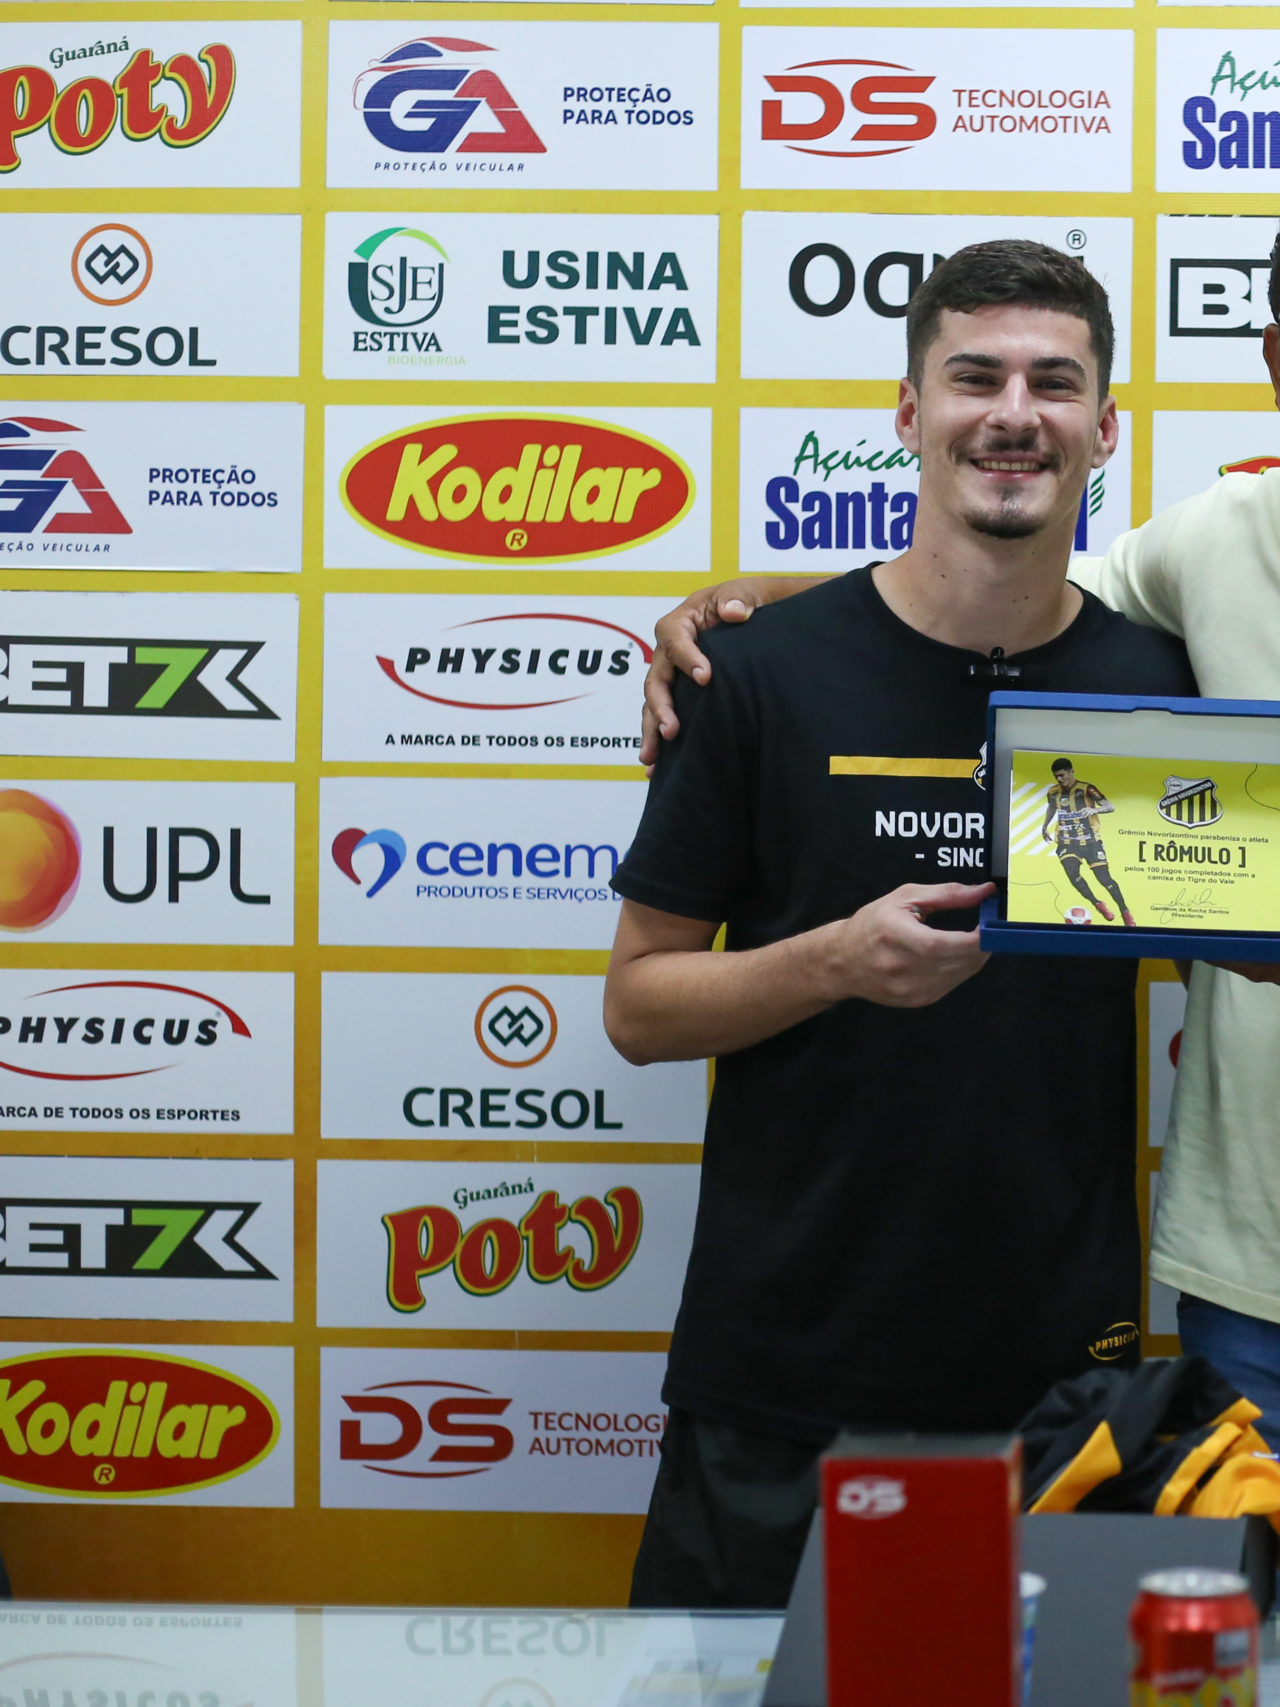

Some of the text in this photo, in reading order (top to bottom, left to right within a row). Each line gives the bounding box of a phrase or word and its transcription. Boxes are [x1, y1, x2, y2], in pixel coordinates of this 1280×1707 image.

[564, 84, 671, 107] PROTEÇÃO
[952, 89, 1110, 108] TECNOLOGIA
[363, 69, 547, 153] GA
[563, 109, 693, 125] PARA TODOS
[761, 75, 937, 141] DS
[952, 115, 1111, 133] AUTOMOTIVA
[374, 161, 524, 173] PROTEÇÃO VEICULAR
[503, 250, 688, 290] USINA
[488, 305, 701, 346] ESTIVA
[0, 325, 217, 366] CRESOL
[353, 331, 442, 352] ESTIVA
[387, 354, 466, 366] BIOENERGIA
[148, 465, 256, 487] PROTEÇÃO
[386, 443, 661, 523] Kodilar
[149, 490, 278, 507] PARA TODOS
[43, 543, 110, 552] VEICULAR
[405, 646, 631, 676] PHYSICUS
[0, 644, 262, 711] ET7K
[385, 734, 642, 749] A MARCA DE TODOS OS ESPORTE
[416, 841, 624, 878] cenem
[937, 846, 984, 868] SINC
[1154, 840, 1230, 865] RÔMULO
[102, 826, 271, 905] UPL
[417, 885, 508, 899] PRODUTOS
[513, 887, 522, 899] E
[527, 887, 607, 903] SERVIÇOS
[0, 1106, 240, 1121] ARCA DE TODOS OS ESPORTES
[403, 1087, 623, 1130] CRESOL
[0, 1207, 259, 1272] ET7K
[381, 1186, 643, 1314] Poty
[340, 1396, 514, 1463] DS
[529, 1411, 668, 1433] TECNOLOGI
[529, 1437, 662, 1458] AUTOMOTI
